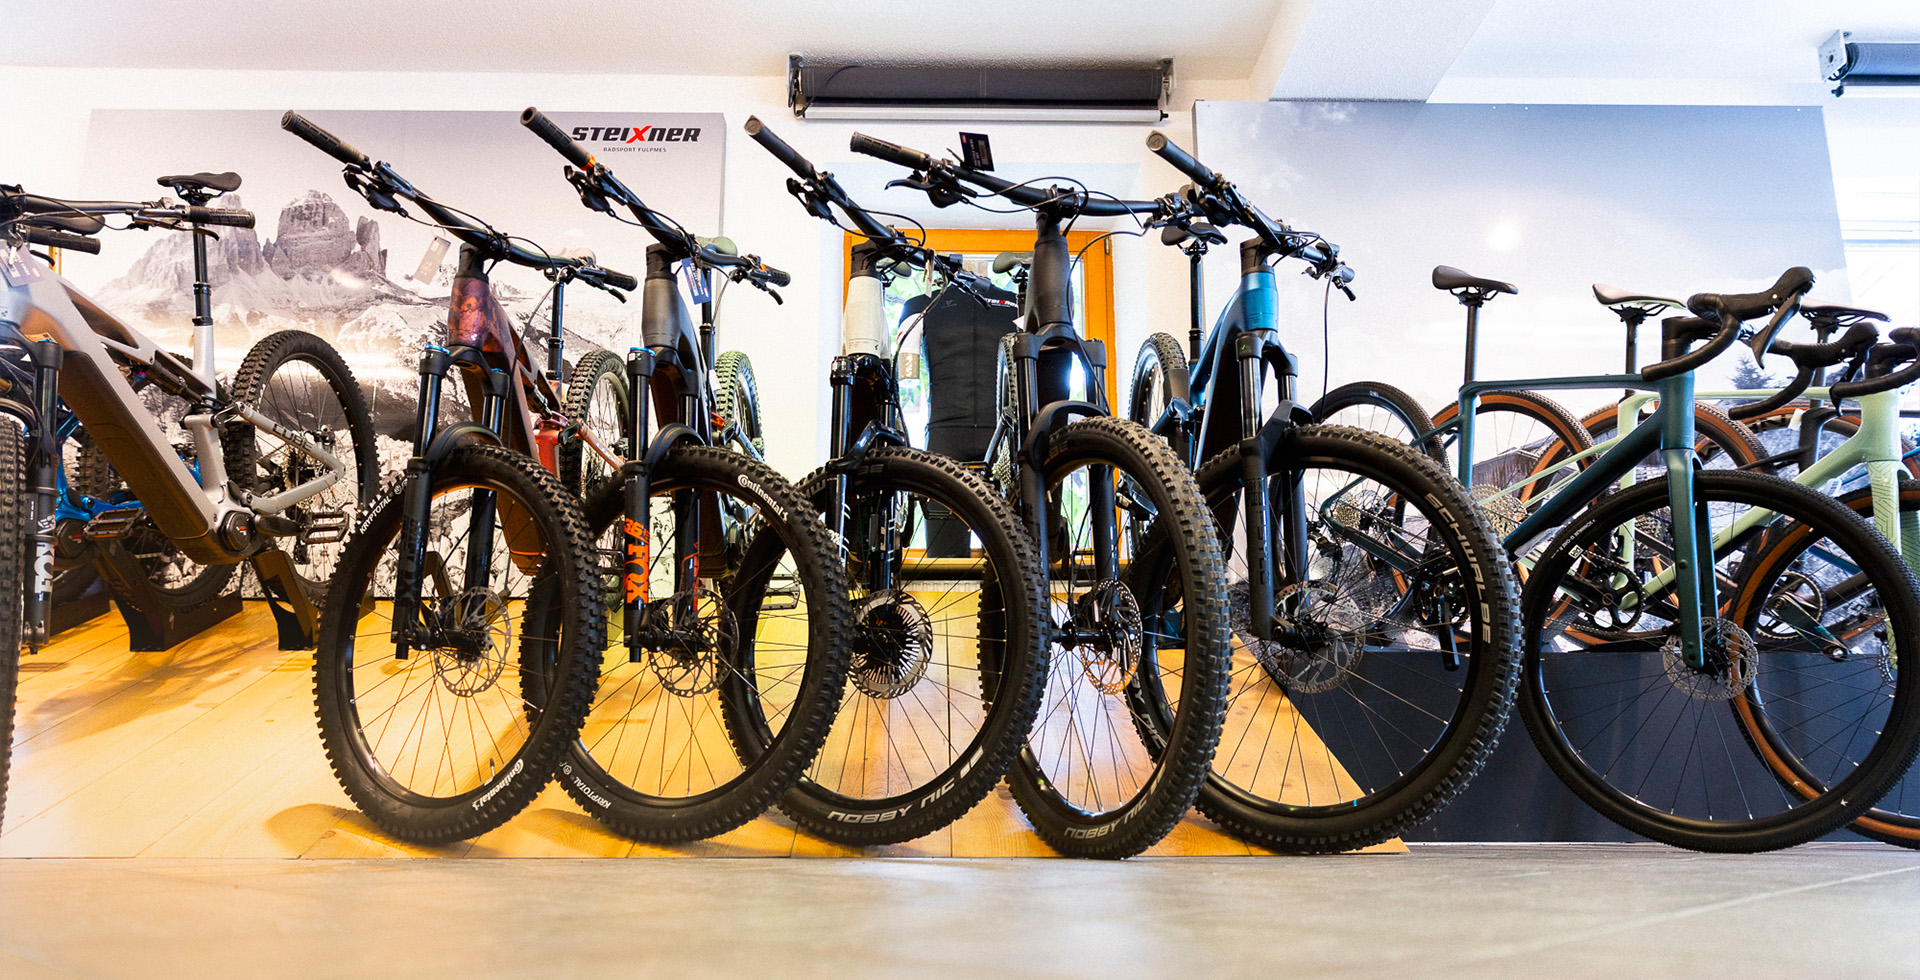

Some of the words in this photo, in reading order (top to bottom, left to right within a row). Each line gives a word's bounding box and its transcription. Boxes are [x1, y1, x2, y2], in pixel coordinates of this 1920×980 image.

[272, 423, 313, 452] CUBE
[359, 495, 392, 535] KRYPTOTAL
[1424, 492, 1492, 644] SCHWALBE
[573, 776, 612, 809] KRYPTOTAL
